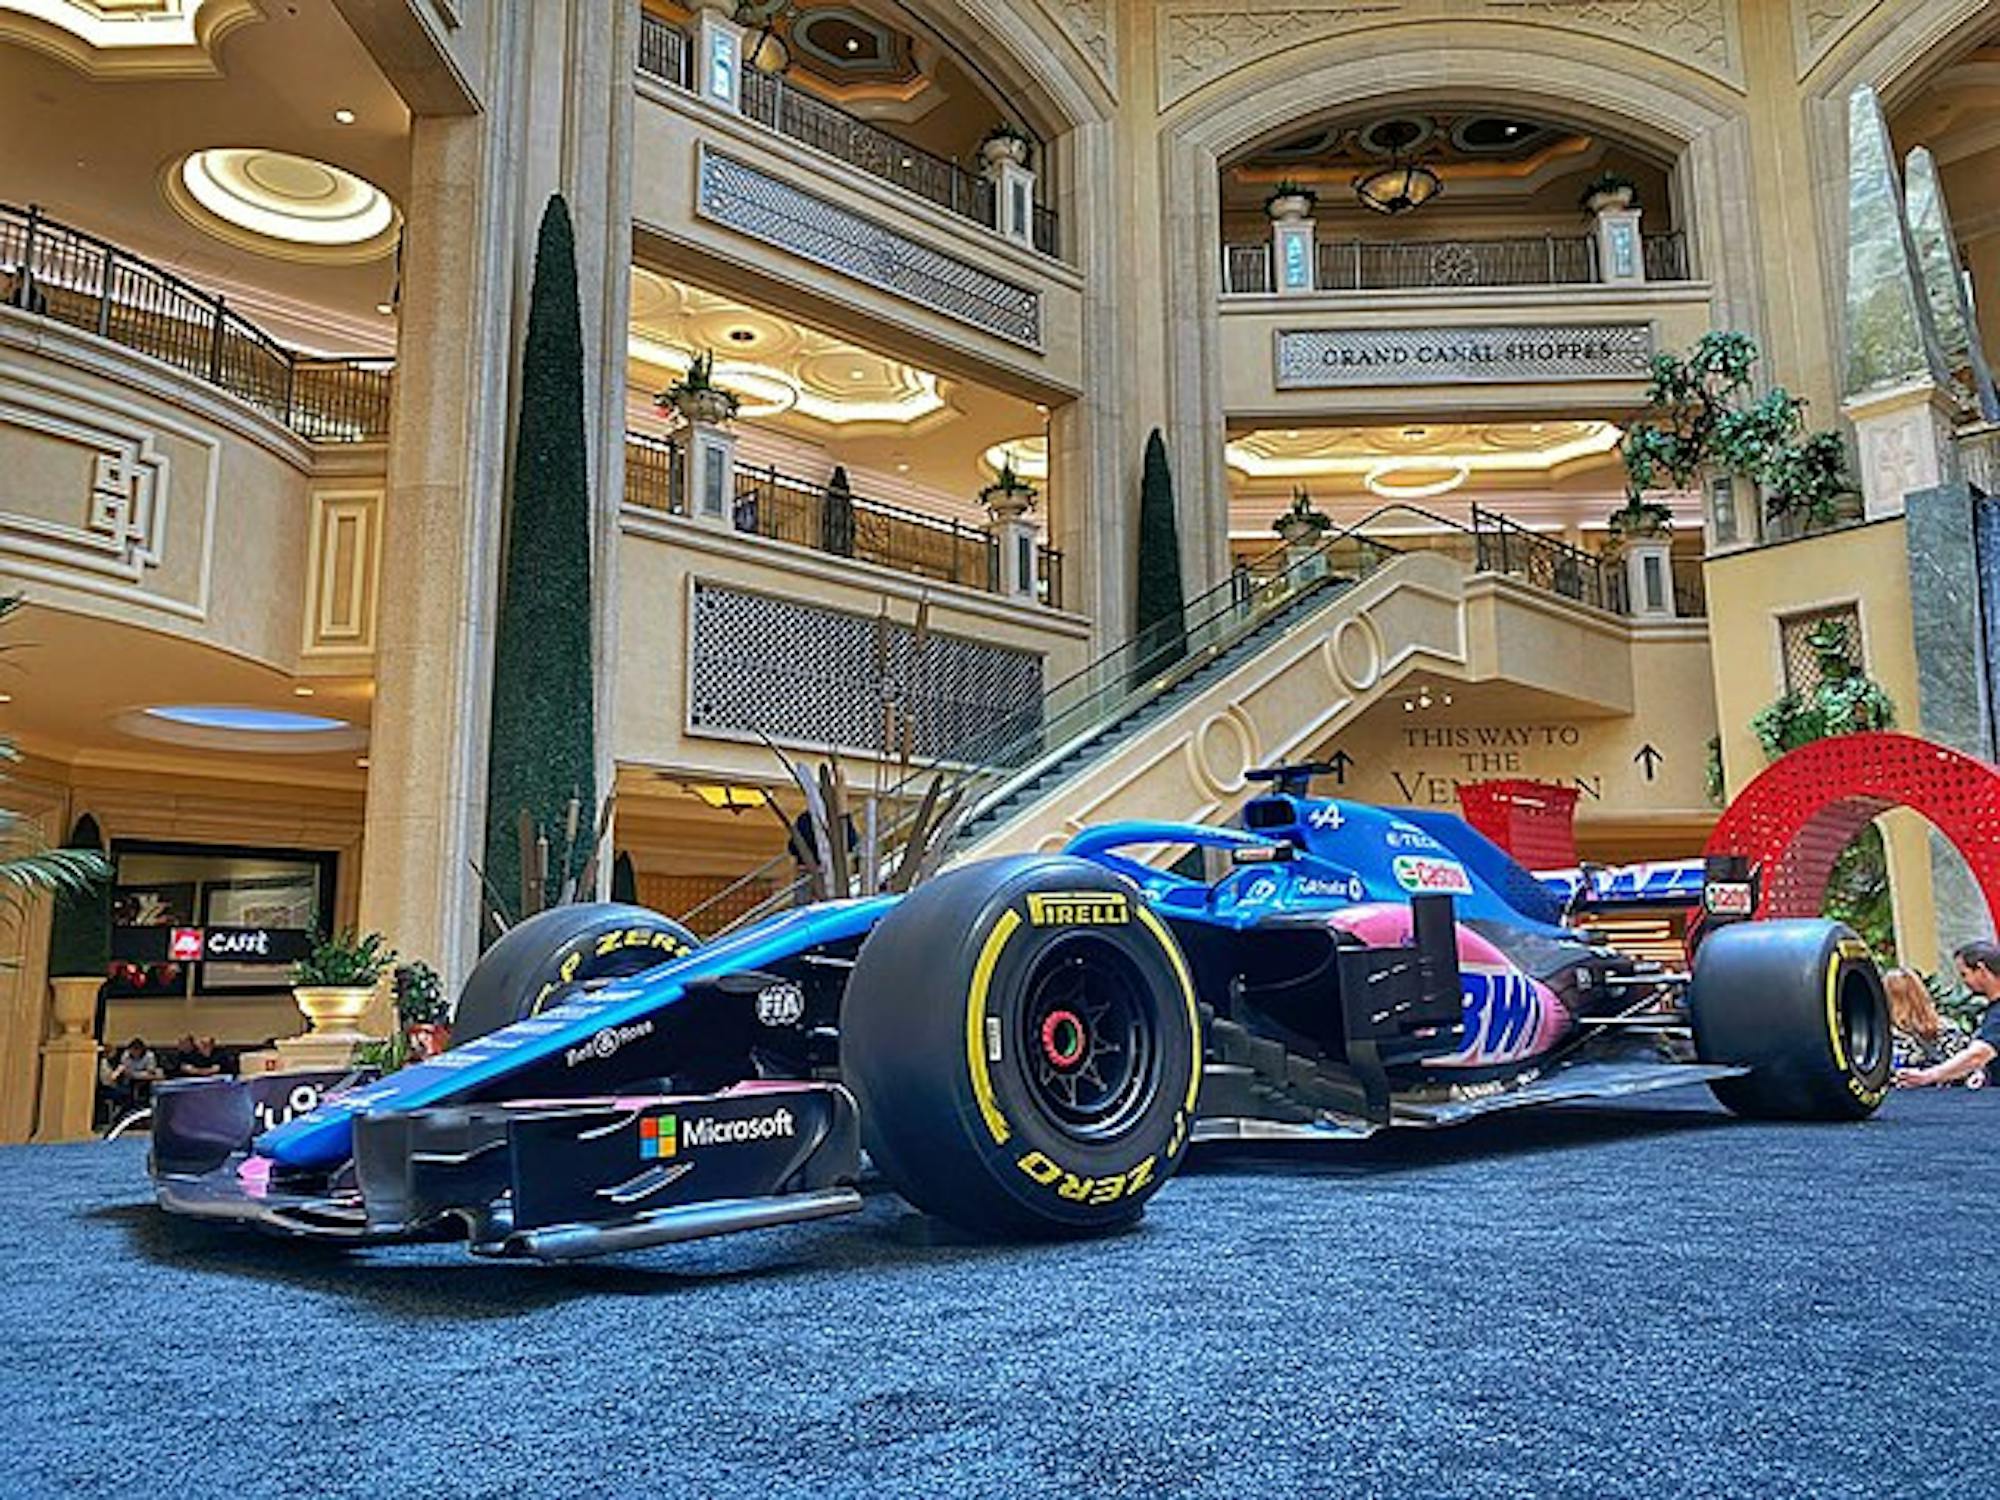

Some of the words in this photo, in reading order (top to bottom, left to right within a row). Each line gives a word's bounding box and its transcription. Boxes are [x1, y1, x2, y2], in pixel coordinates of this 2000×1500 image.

[1322, 349, 1407, 366] GRAND
[1415, 346, 1497, 363] CANAL
[1506, 342, 1612, 361] SHOPPES
[1402, 727, 1470, 747] THIS
[1475, 726, 1532, 746] WAY
[1542, 725, 1579, 745] TO
[1460, 752, 1521, 772] THE
[1027, 891, 1130, 926] PIRELLI
[759, 991, 799, 1018] FIA
[682, 1107, 795, 1149] Microsoft
[1016, 1150, 1158, 1206] ZERO
